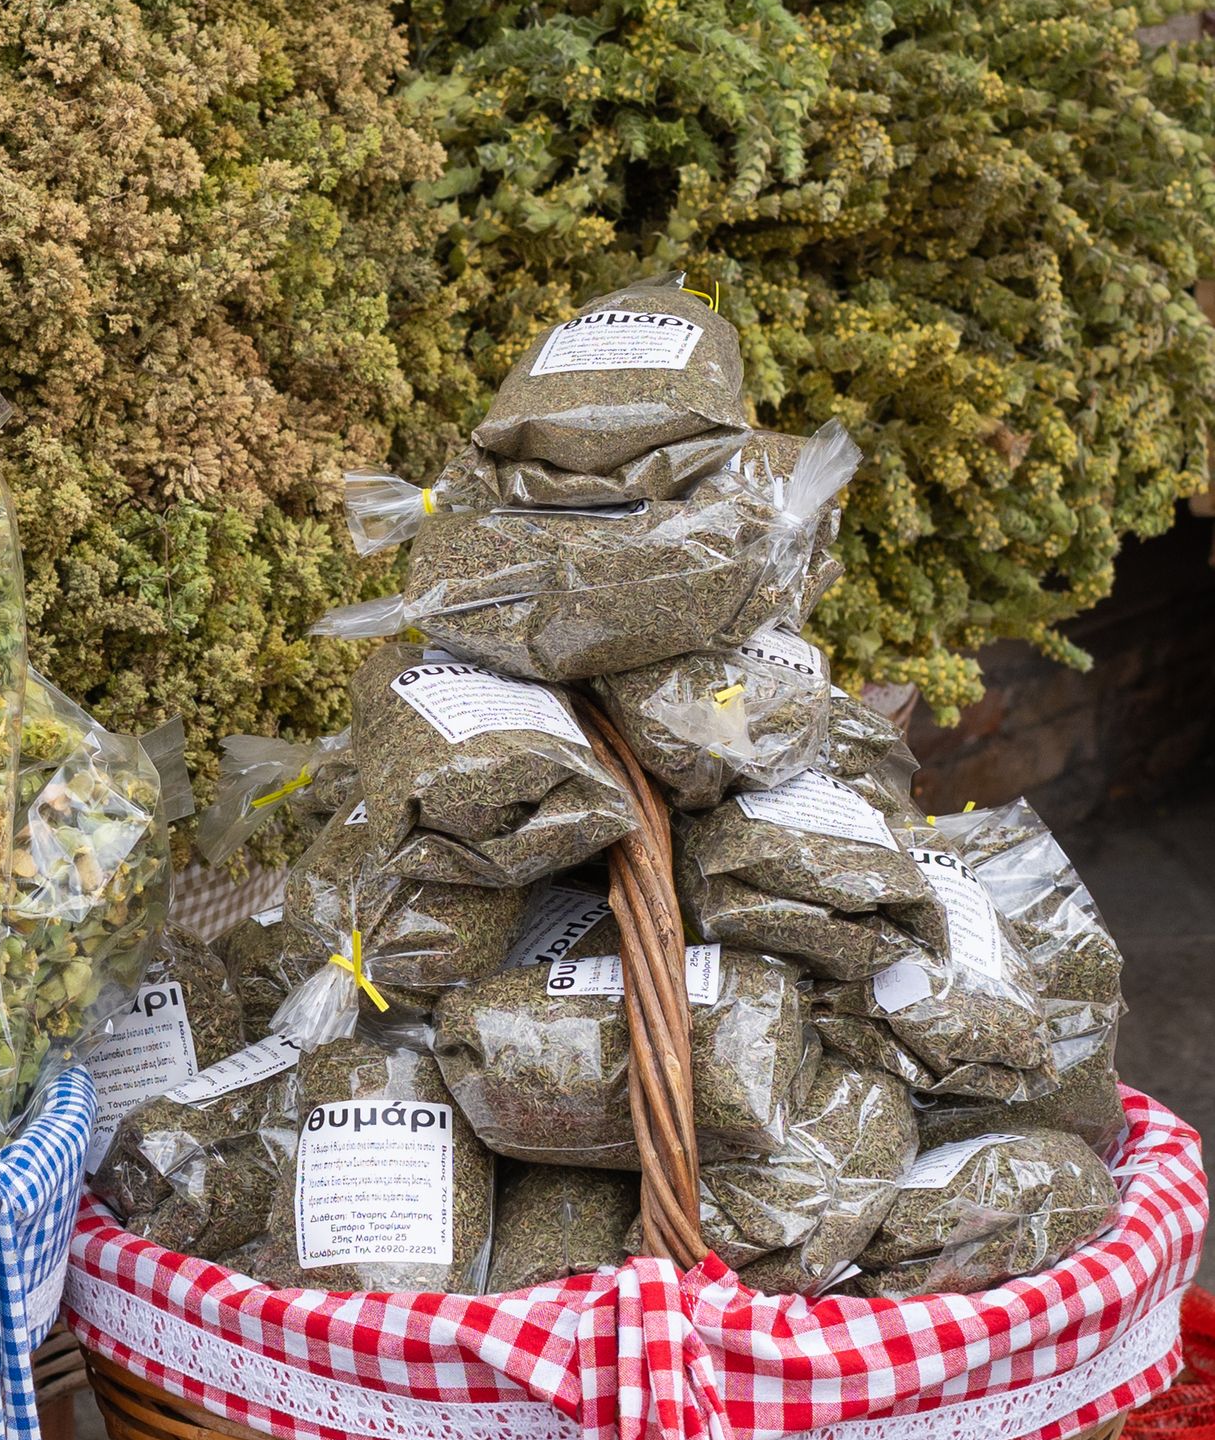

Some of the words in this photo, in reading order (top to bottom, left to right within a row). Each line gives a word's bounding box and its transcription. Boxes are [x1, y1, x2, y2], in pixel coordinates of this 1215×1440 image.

[563, 313, 695, 331] θυμάρι
[94, 1112, 124, 1125] μπόριο
[307, 1101, 447, 1133] θυμάρι
[390, 1210, 433, 1221] Δημήτρης
[330, 1223, 366, 1233] Εμπόριο
[331, 1235, 353, 1244] 25ης
[355, 1233, 393, 1243] Μαρτίου
[395, 1233, 407, 1241] 25
